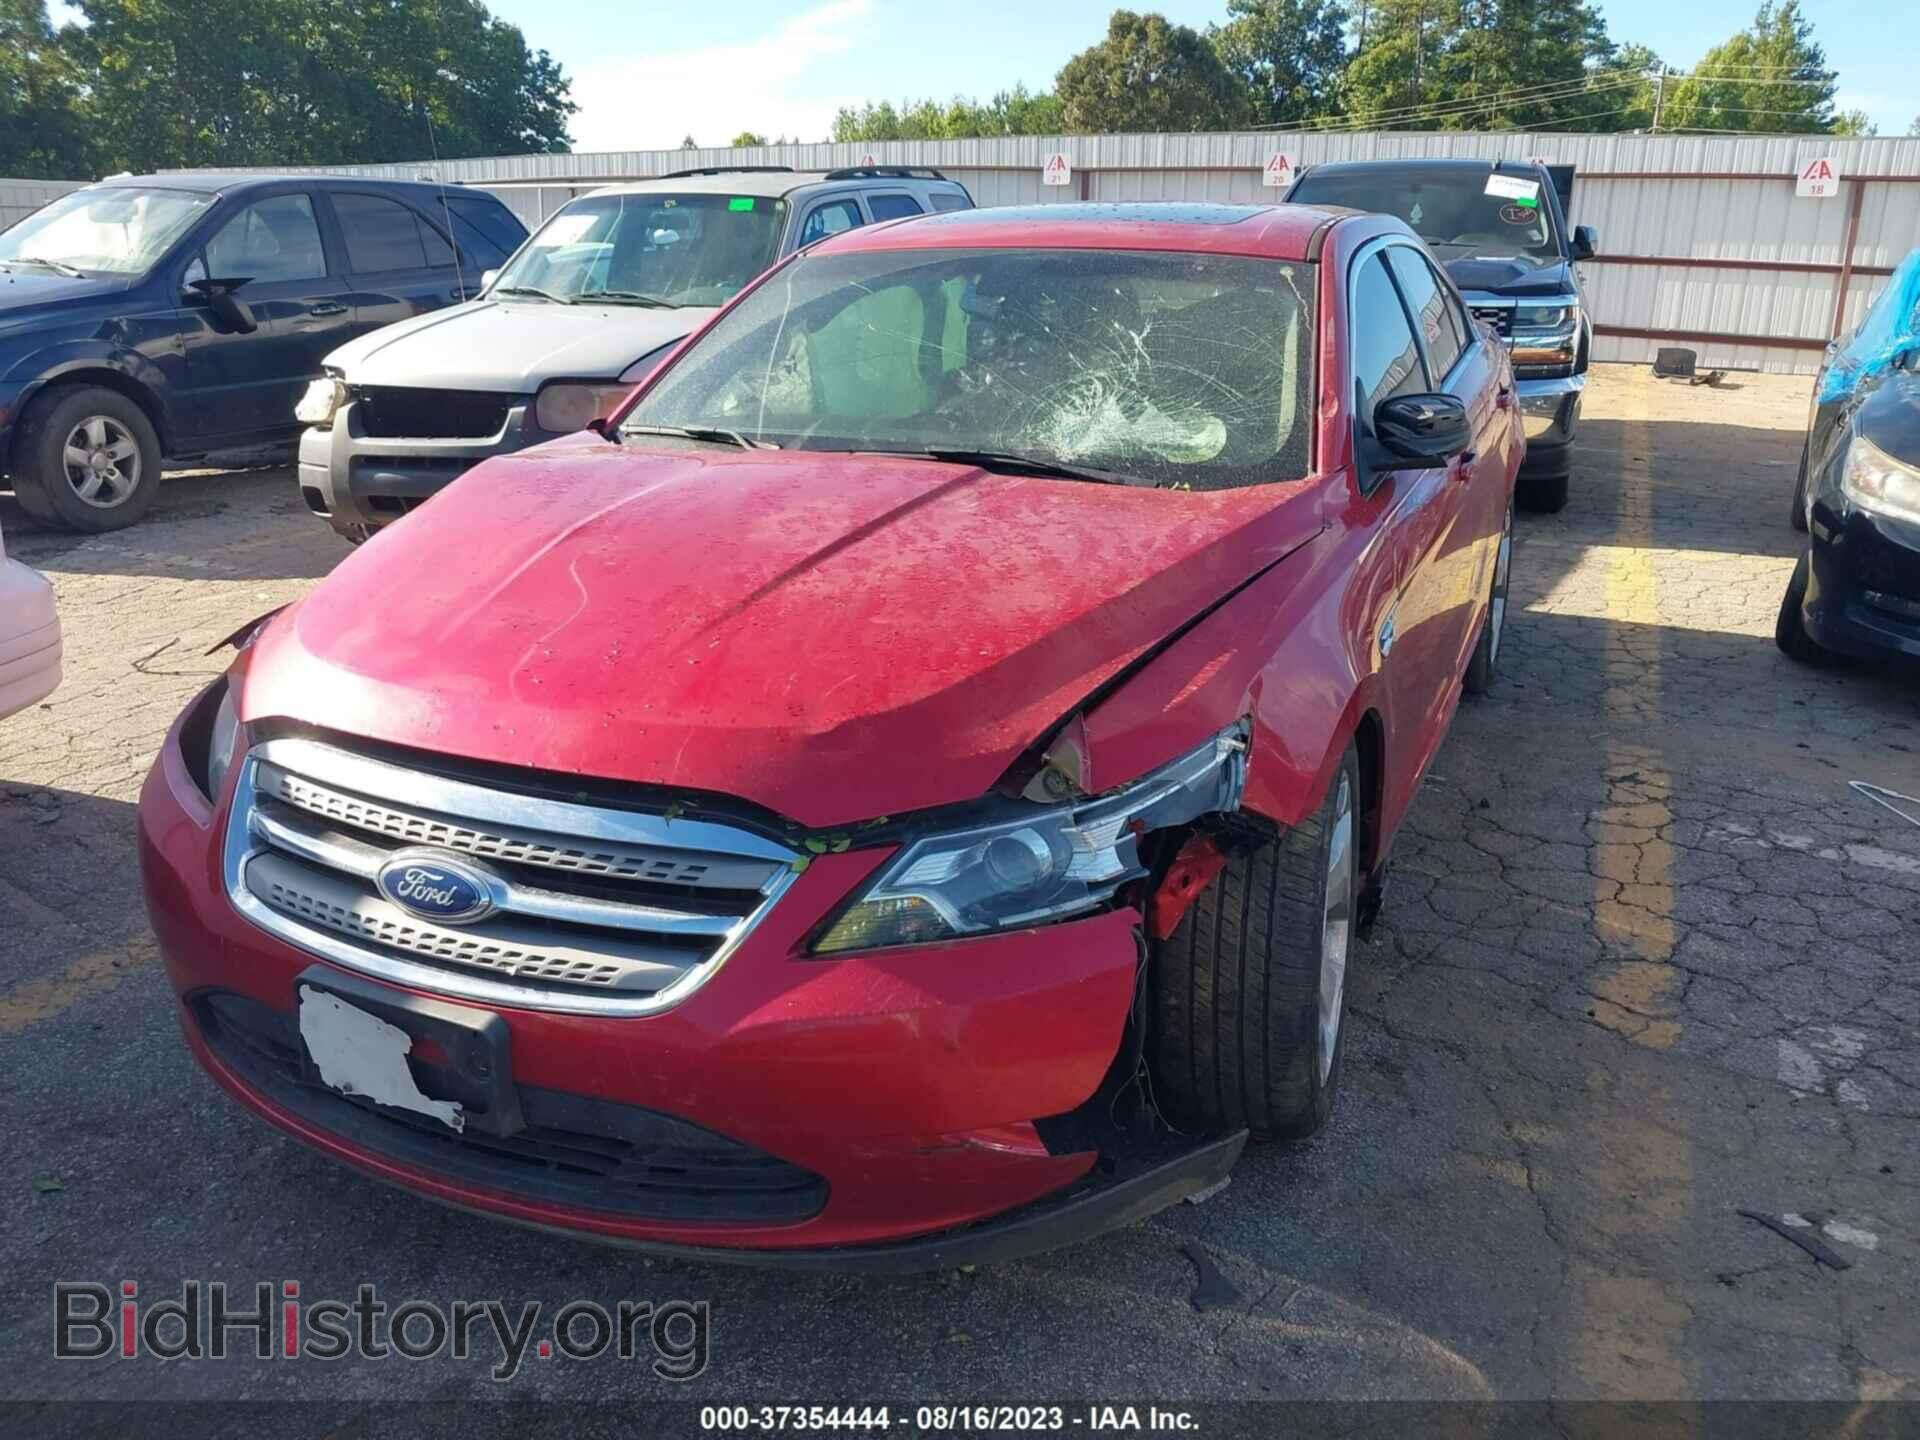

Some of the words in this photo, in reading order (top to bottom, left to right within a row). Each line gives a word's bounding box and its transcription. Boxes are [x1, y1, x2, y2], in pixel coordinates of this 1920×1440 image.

[1272, 175, 1285, 185] 20
[1811, 184, 1824, 195] 18
[397, 868, 458, 907] Ford
